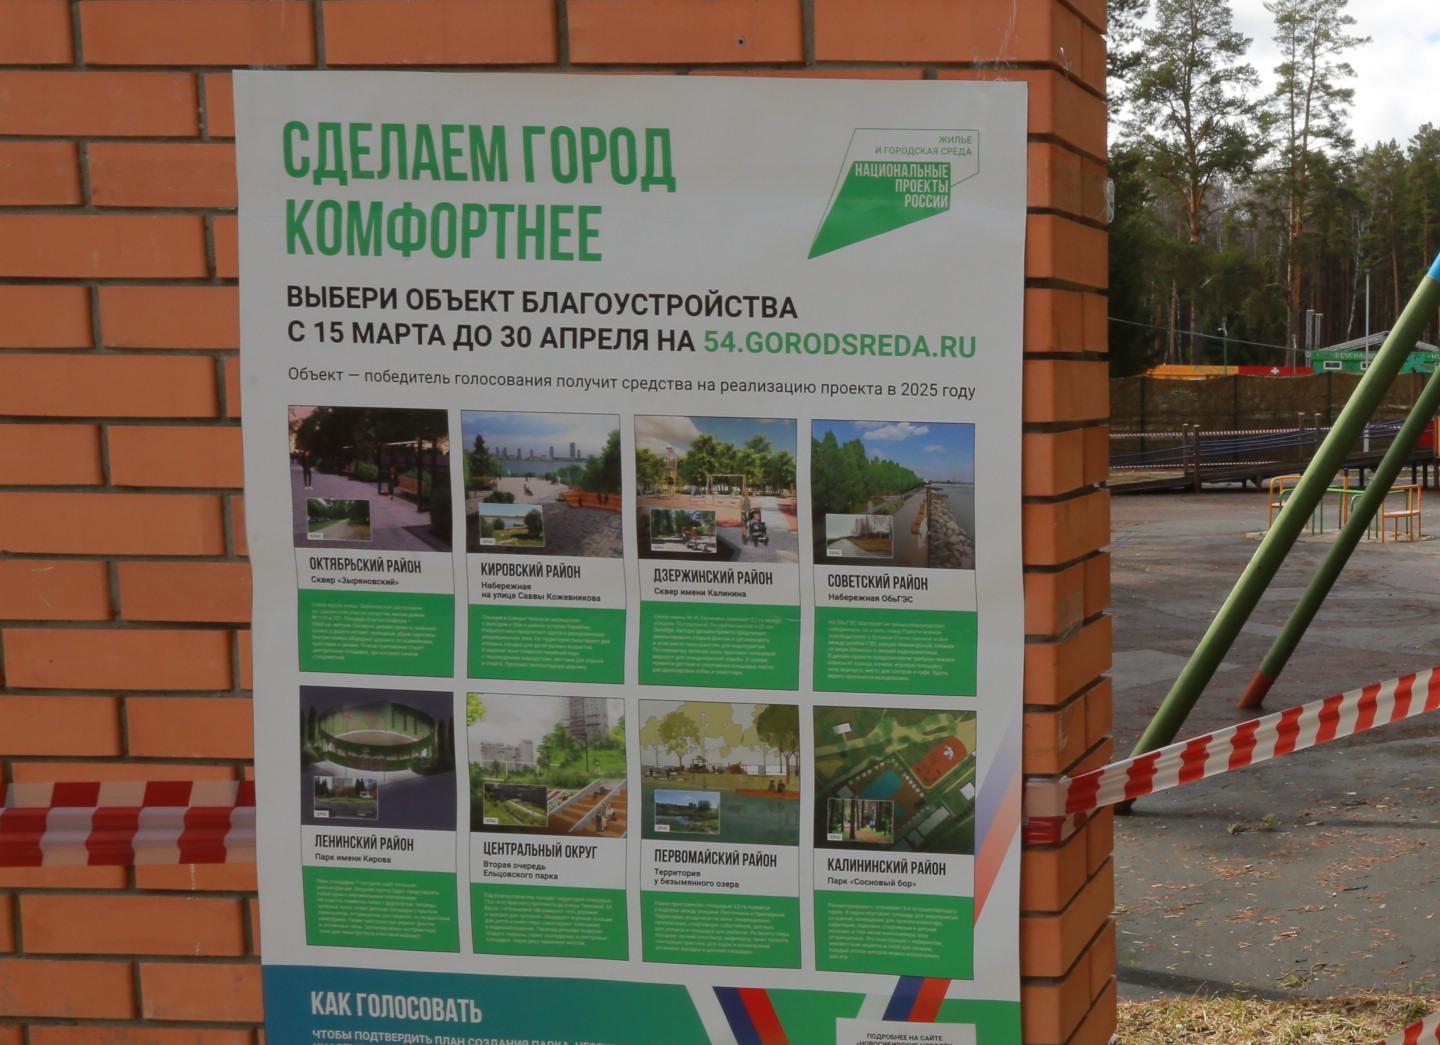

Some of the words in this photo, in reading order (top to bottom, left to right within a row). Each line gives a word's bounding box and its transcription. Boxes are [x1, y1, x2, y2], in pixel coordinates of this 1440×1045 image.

[939, 136, 972, 144] ЖИЛЬЕ
[282, 121, 509, 186] СДЕЛАЕМ
[523, 126, 676, 192] ГОРОД
[884, 147, 938, 155] ГОРОДСКАЯ
[941, 148, 972, 156] СРЕДА
[855, 163, 948, 178] НАЦИОНАЛЬНЫЕ
[896, 179, 948, 193] ПРОЕКТЫ
[905, 194, 948, 208] РОССИИ
[286, 199, 603, 262] КОМФОРТНЕЕ
[287, 285, 398, 311] ВЫБЕРИ
[406, 288, 514, 314] ОБЪЕКТ
[522, 288, 798, 320] БЛАГОУСТРОЙСТВА
[288, 320, 305, 344] С
[314, 321, 344, 344] 15
[352, 321, 445, 348] МАРТА
[453, 324, 491, 352] ДО
[500, 325, 532, 349] 30
[540, 326, 649, 352] АПРЕЛЯ
[658, 329, 696, 353] НА
[703, 329, 977, 359] 54.GORODSREDA.RU
[288, 366, 344, 384] Объект
[365, 369, 449, 388] победитель
[454, 371, 551, 389] голосования
[556, 374, 618, 394] получит
[622, 377, 692, 395] средства
[698, 380, 716, 392] на
[720, 379, 816, 398] реализацию
[821, 381, 882, 399] проекта
[888, 384, 896, 395] в
[901, 381, 938, 398] 2025
[941, 384, 976, 401] году
[309, 557, 384, 572] ОКТЯБРЬСКИЙ
[387, 558, 422, 573] РАЙОН
[481, 562, 543, 577] КИРОВСКИЙ
[546, 563, 581, 578] РАЙОН
[312, 576, 335, 584] Сквер
[338, 577, 398, 586] «Зыряновский»
[654, 568, 734, 584] ДЗЕРЖИНСКИЙ
[738, 569, 773, 585] РАЙОН
[828, 574, 890, 589] СОВЕТСКИЙ
[893, 574, 928, 590] РАЙОН
[482, 582, 531, 590] Набережная
[654, 588, 678, 596] Сквер
[518, 592, 544, 600] Саввы
[547, 593, 600, 601] Кожевникова
[829, 593, 879, 602] Набережная
[882, 595, 912, 603] ОбьГЭС
[314, 834, 377, 849] ЛЕНИНСКИЙ
[380, 836, 414, 851] РАЙОН
[483, 842, 562, 857] ЦЕНТРАЛЬНЫЙ
[565, 845, 598, 858] ОКРУГ
[315, 853, 335, 862] Парк
[363, 855, 391, 863] Кирова
[483, 861, 511, 869] Вторая
[655, 849, 739, 865] ПЕРВОМАЙСКИЙ
[742, 851, 777, 867] РАЙОН
[655, 868, 700, 877] Территория
[828, 858, 908, 874] КАЛИНИНСКИЙ
[911, 860, 946, 875] РАЙОН
[483, 870, 533, 879] Ельцовского
[661, 878, 714, 887] безымянного
[828, 877, 848, 885] Парк
[850, 878, 895, 887] «Сосновый
[898, 880, 916, 888] бор»
[311, 991, 352, 1016] КАК
[356, 992, 482, 1024] ГОЛОСОВАТЬ
[313, 1030, 351, 1040] ЧТОБЫ
[355, 1032, 432, 1044] ПОДТВЕРДИТЬ
[435, 1036, 466, 1045] ПЛАН
